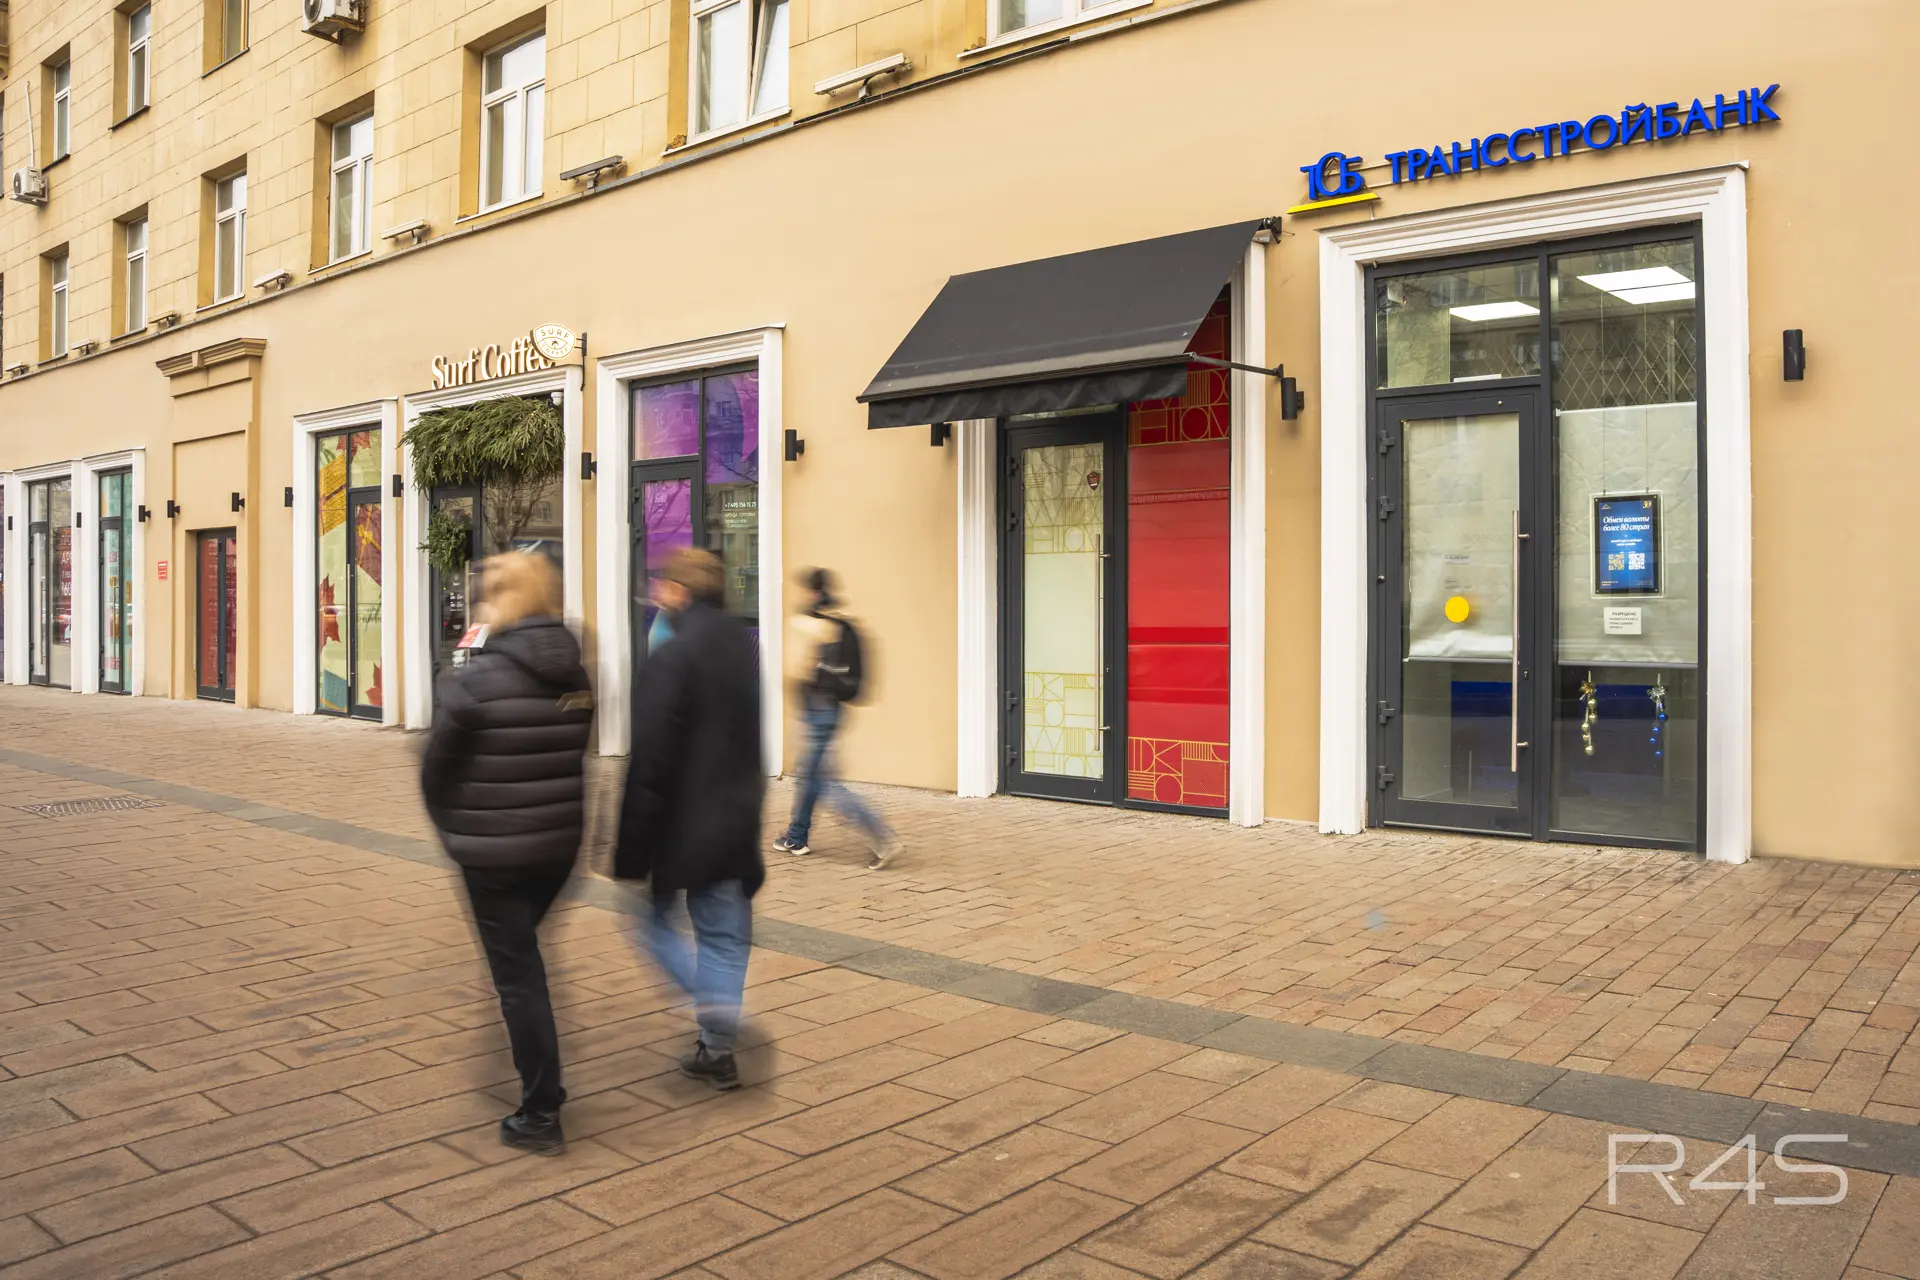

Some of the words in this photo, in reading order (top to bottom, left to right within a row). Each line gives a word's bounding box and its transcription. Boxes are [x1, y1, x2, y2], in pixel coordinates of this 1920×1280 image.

[1385, 84, 1781, 184] ТРАНССТРОЙБАНК
[541, 328, 570, 339] SURF
[432, 347, 480, 390] Surf
